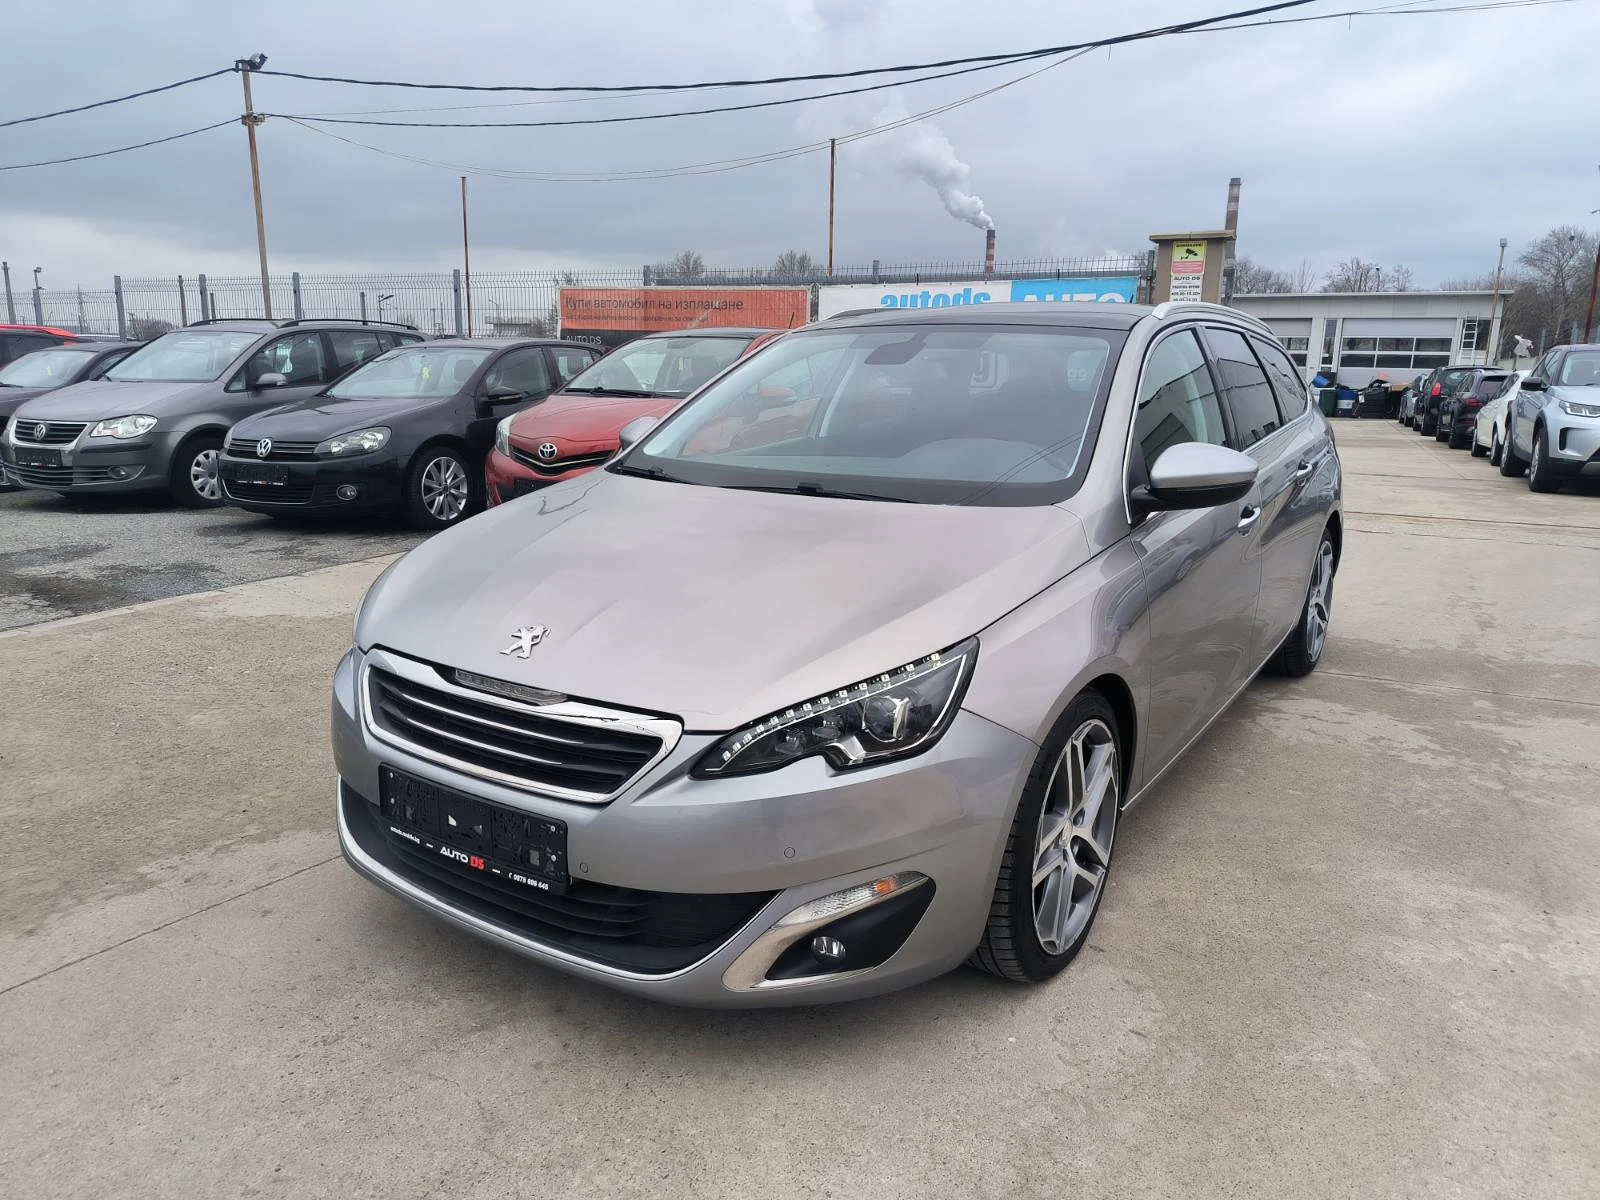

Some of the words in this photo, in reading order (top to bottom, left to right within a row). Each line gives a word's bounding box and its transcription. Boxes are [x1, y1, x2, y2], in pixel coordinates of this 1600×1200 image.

[566, 296, 592, 310] Купи
[594, 297, 654, 309] автомобил
[658, 300, 672, 309] на
[675, 300, 744, 312] изплащане
[440, 846, 469, 863] AUTO
[470, 855, 485, 870] DS
